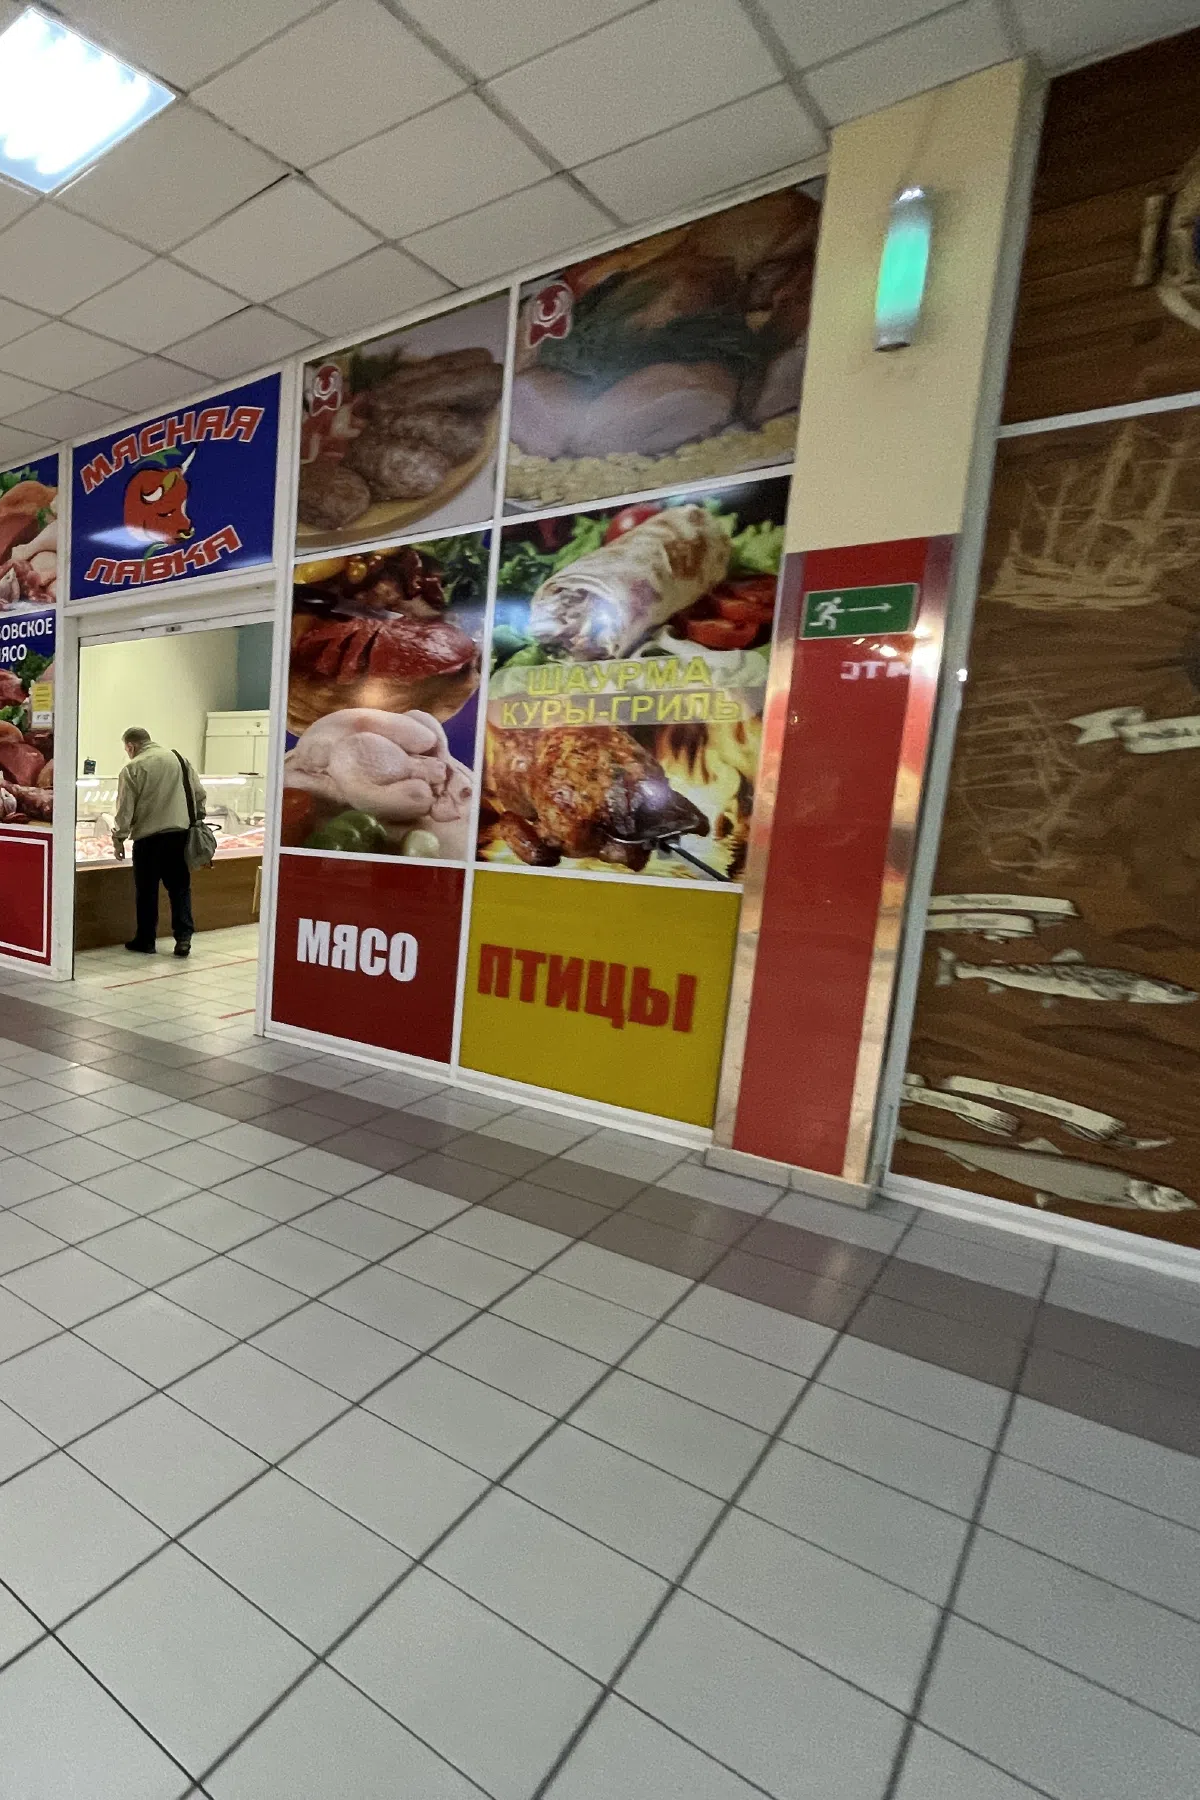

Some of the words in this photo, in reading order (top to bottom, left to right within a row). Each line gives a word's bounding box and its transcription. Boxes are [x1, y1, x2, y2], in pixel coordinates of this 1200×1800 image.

[79, 405, 265, 494] МЯСНАЯ
[84, 525, 243, 585] ЛАВКА
[527, 655, 712, 696] ШАУРМА
[502, 691, 742, 727] КУРЫ-ГРИЛЬ
[296, 917, 419, 983] МЯСО
[477, 943, 698, 1033] ПТИЦЫ
